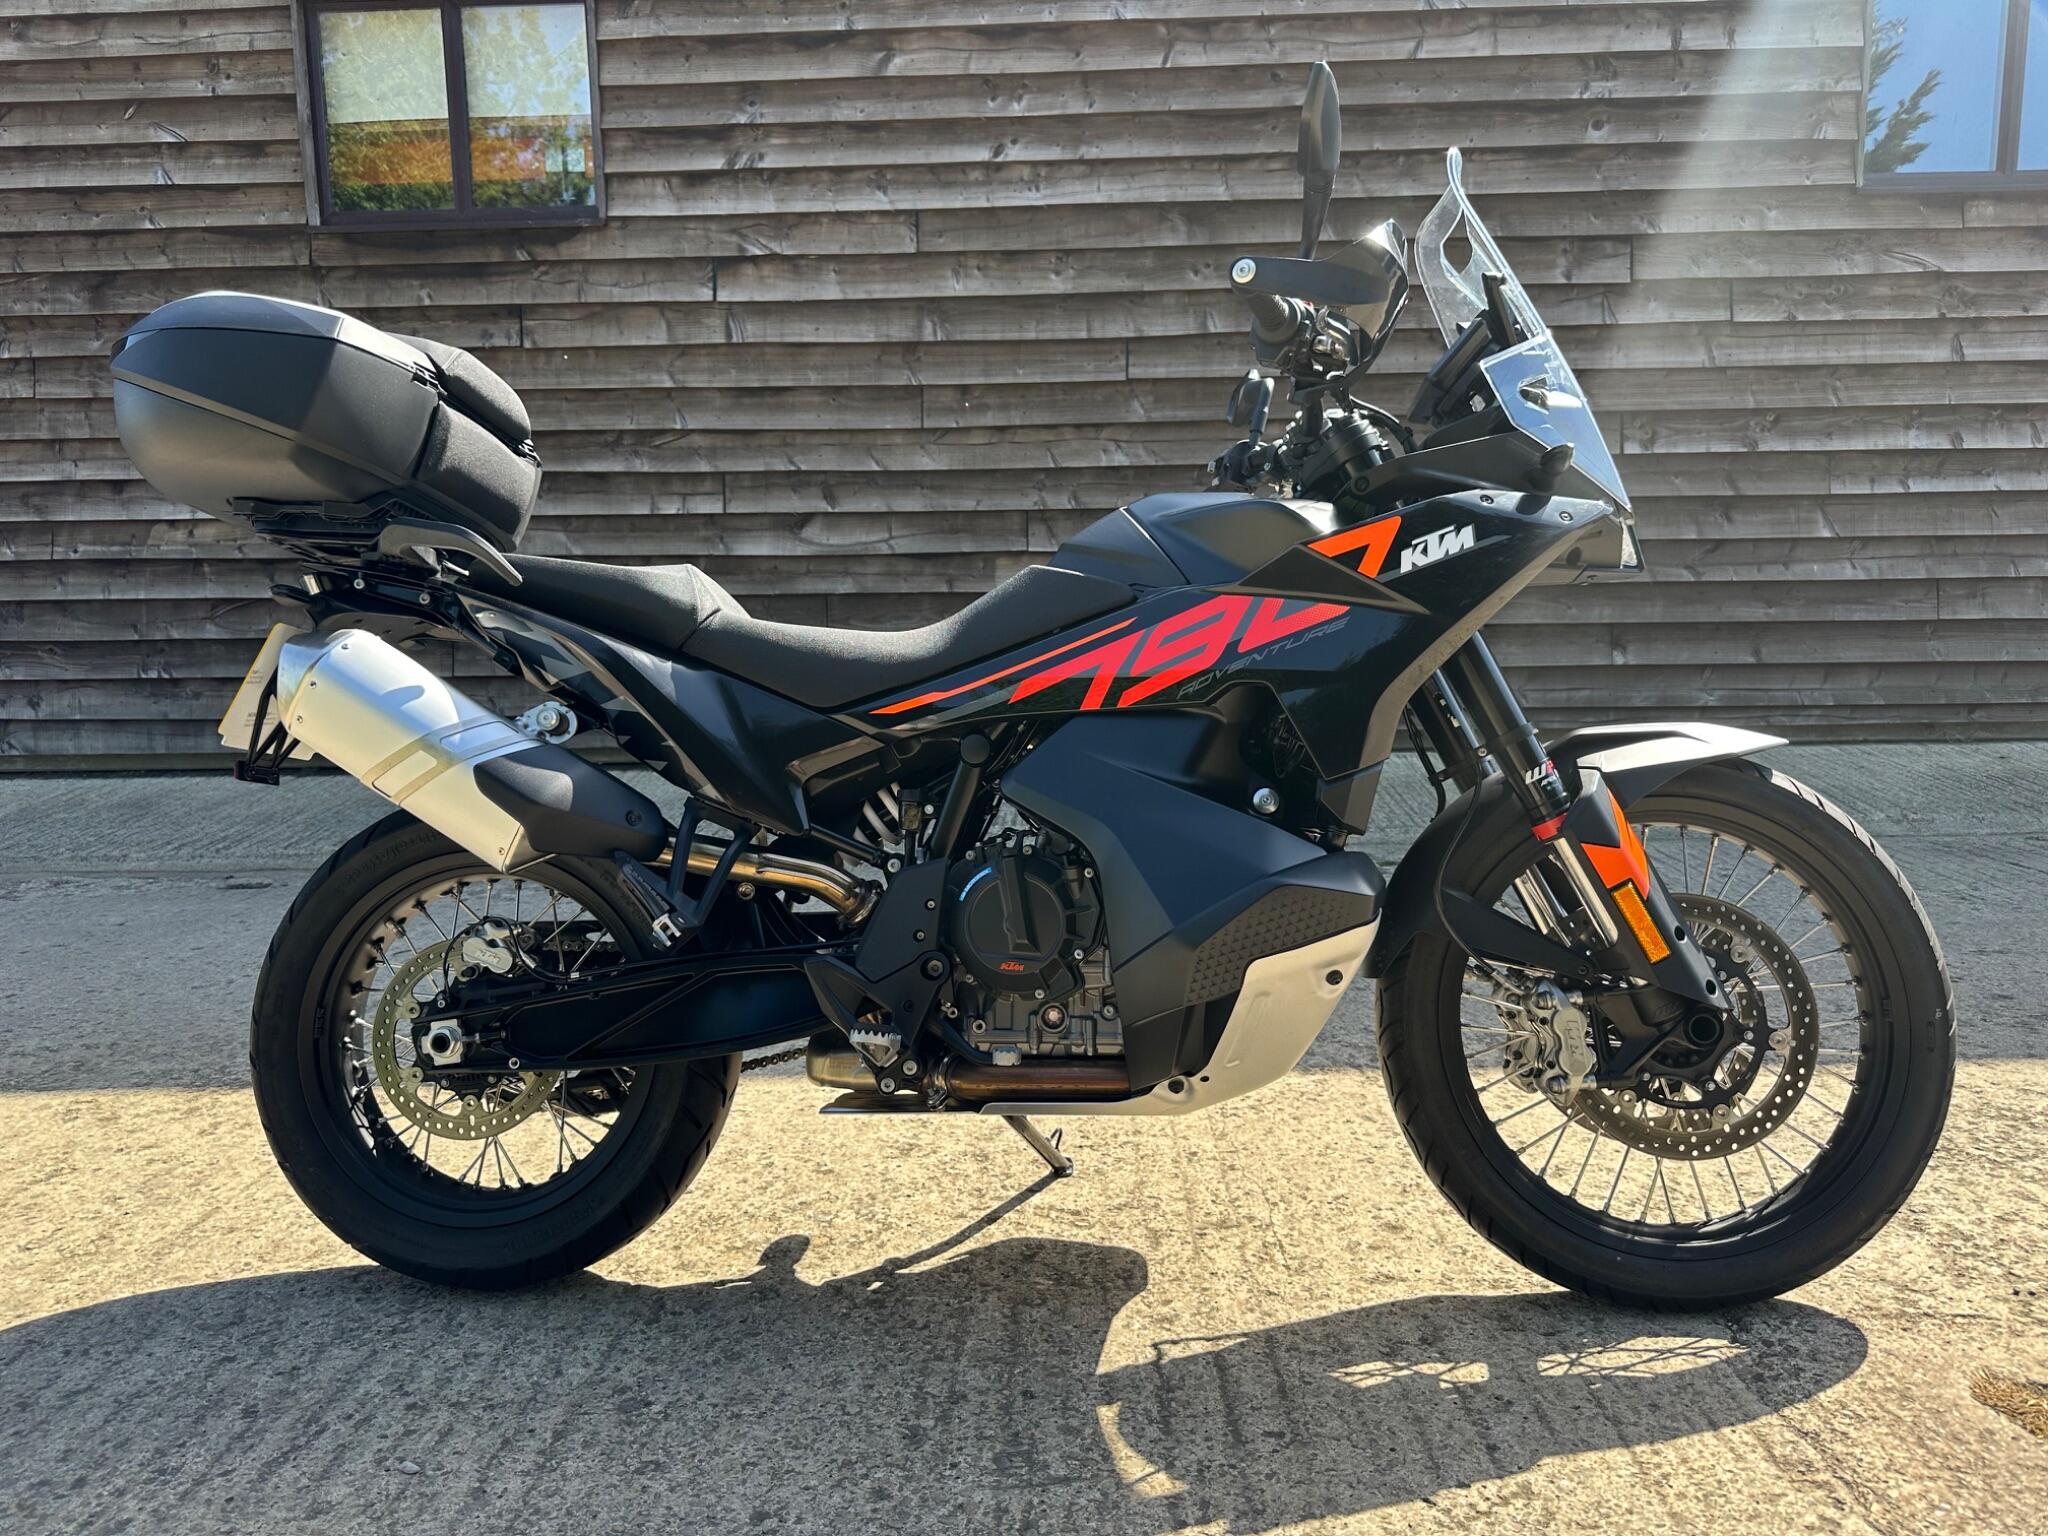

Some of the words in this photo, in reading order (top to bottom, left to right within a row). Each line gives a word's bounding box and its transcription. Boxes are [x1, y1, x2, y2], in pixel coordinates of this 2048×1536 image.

[1400, 523, 1476, 574] KTM
[1176, 616, 1351, 700] ADVENTURE
[1000, 961, 1025, 971] KTM
